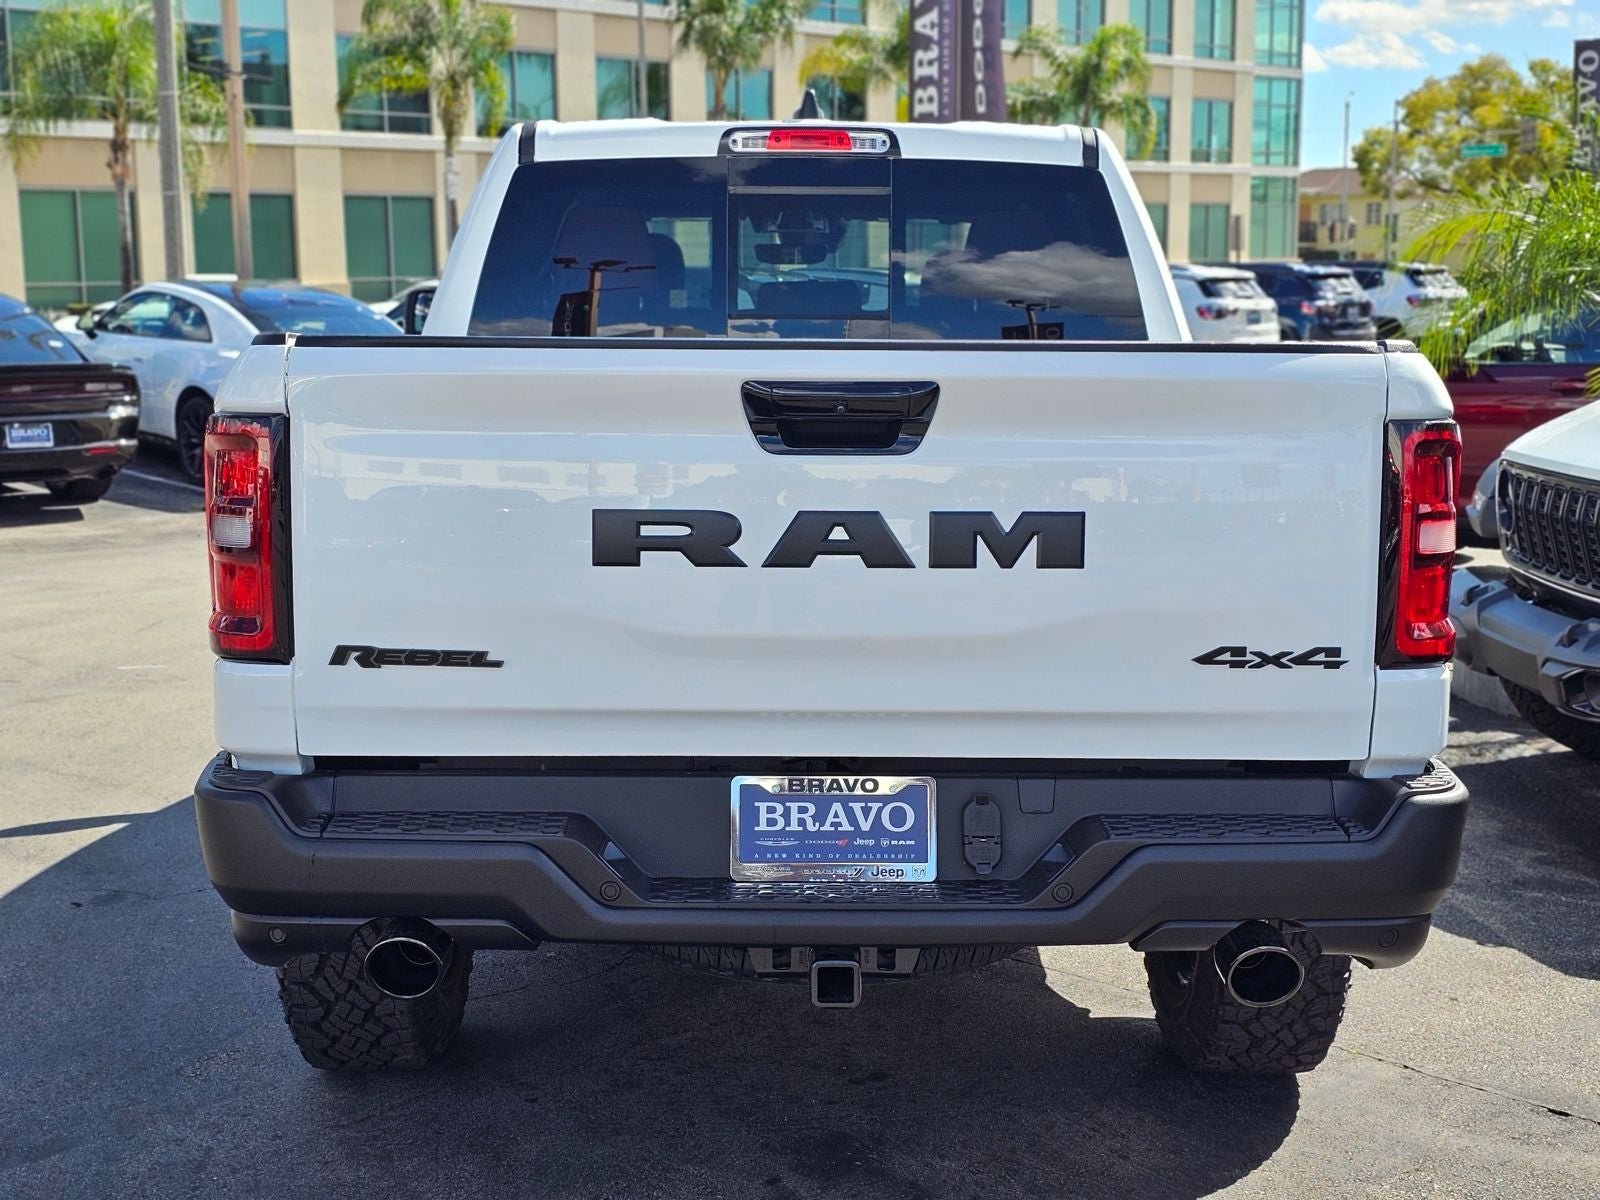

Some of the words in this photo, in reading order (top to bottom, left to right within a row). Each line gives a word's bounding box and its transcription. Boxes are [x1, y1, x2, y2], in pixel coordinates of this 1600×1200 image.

[913, 0, 939, 118] BRA
[592, 508, 1086, 570] RAM
[328, 644, 504, 669] REBEL
[787, 777, 880, 794] BRAVO
[754, 801, 916, 833] BRAVO
[853, 837, 875, 847] Jeep
[871, 866, 905, 879] Jeep
